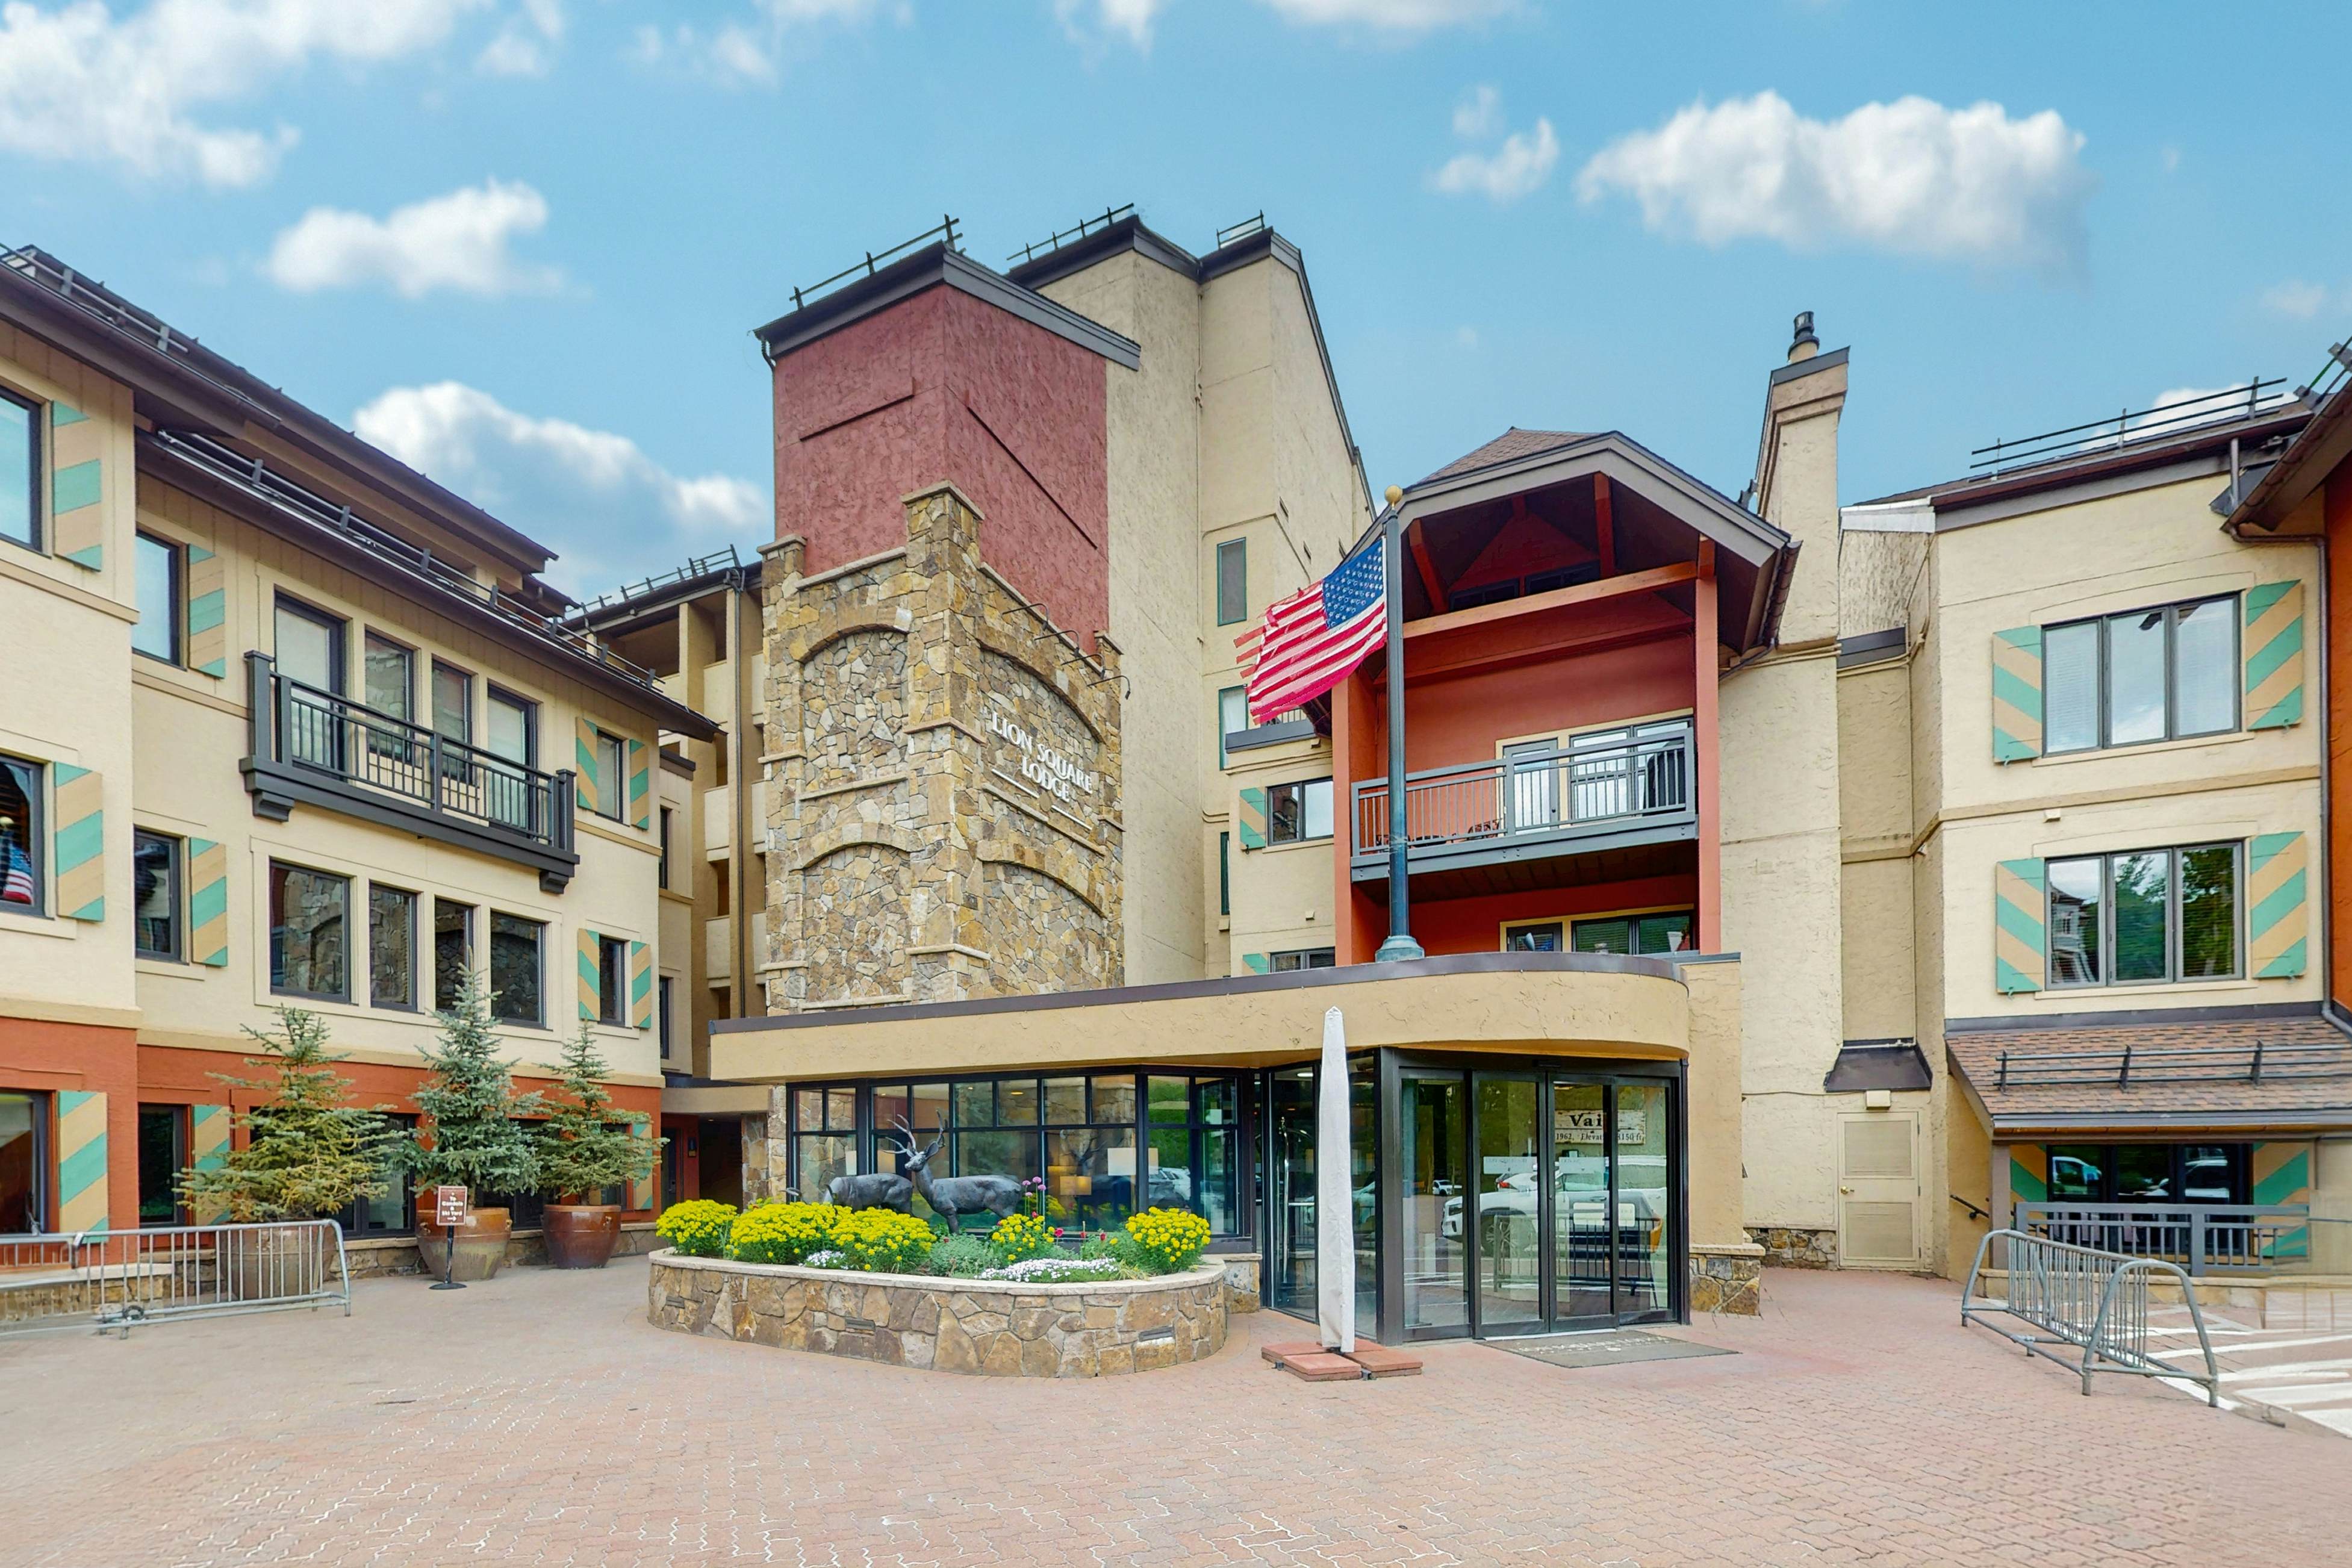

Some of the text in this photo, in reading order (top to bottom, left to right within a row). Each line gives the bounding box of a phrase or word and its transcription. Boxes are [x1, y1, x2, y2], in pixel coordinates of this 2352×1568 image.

[991, 711, 1093, 795] LION SQUARE
[1021, 755, 1070, 803] LODGE
[1569, 1113, 1602, 1127] Vai
